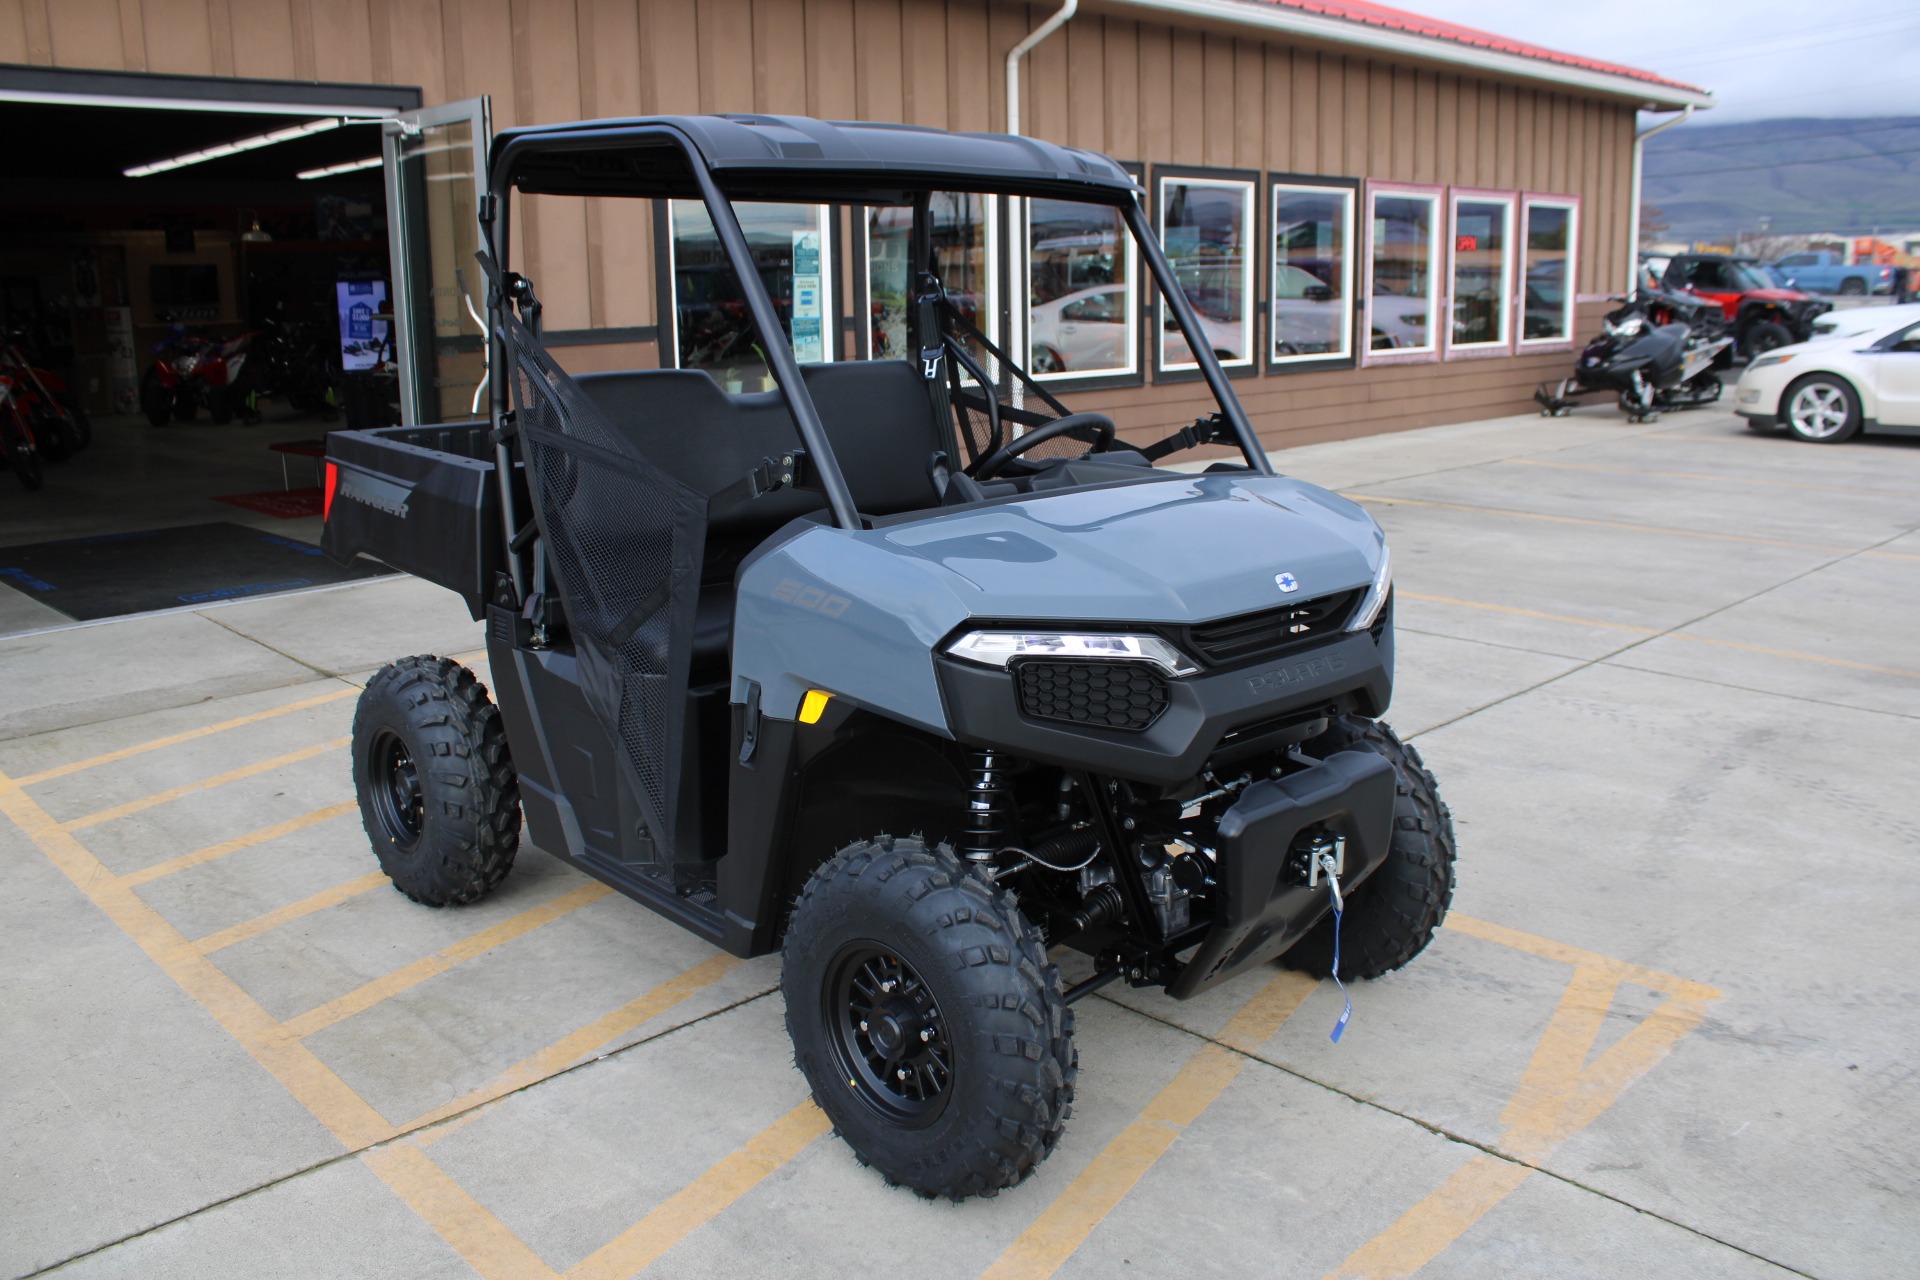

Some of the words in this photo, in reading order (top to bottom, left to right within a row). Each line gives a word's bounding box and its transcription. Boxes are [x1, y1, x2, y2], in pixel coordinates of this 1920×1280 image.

[1457, 236, 1477, 251] OPEN
[339, 481, 410, 520] RANGER
[1244, 651, 1346, 696] POLARIS
